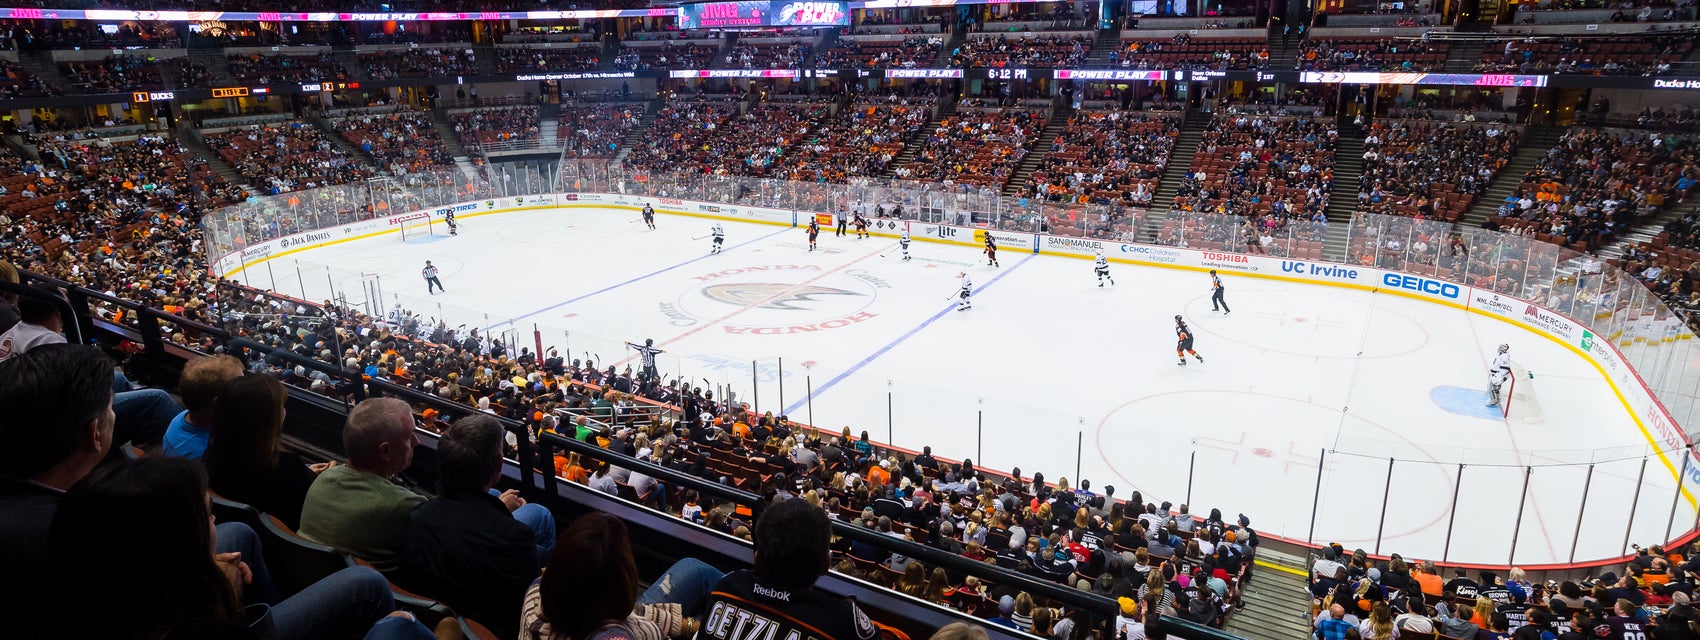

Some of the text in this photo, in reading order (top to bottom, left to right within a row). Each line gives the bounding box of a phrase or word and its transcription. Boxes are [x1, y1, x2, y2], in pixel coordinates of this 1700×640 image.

[9, 8, 42, 18] JMG
[701, 3, 738, 18] JMG
[793, 2, 840, 13] POWER
[257, 12, 281, 20] JMG
[799, 12, 836, 23] PLAY
[988, 69, 1027, 78] 6:12 PM
[1069, 71, 1149, 79] POWER PLAY
[1477, 75, 1514, 86] JMG
[1654, 79, 1685, 88] Ducks
[302, 84, 321, 92] KINGS
[150, 92, 174, 100] DUCKS
[456, 203, 477, 212] TIRES
[659, 198, 683, 206] TOSHIBA
[938, 226, 957, 239] Lite
[290, 236, 306, 247] JACK
[1048, 237, 1064, 245] SAN
[1070, 239, 1104, 250] MANUEL
[1129, 246, 1181, 257] CHOC Children's
[1149, 254, 1176, 263] Hospital
[1203, 252, 1249, 264] TOSHIBA
[1201, 261, 1248, 272] Leading Innovation
[1281, 260, 1358, 280] UC Irvine
[692, 264, 823, 282] HONDA
[845, 269, 893, 289] Center
[1383, 272, 1460, 299] GEICO
[1476, 297, 1513, 313] NHL.COM/GCL
[658, 301, 698, 328] Center
[723, 311, 879, 335] HONDA
[1523, 316, 1572, 340] INSURANCE COMPANY
[1539, 314, 1573, 332] MERCURY
[1583, 335, 1617, 371] enterprise
[1647, 405, 1680, 458] HONDA
[753, 583, 791, 602] Reebok
[705, 600, 822, 640] GETZL
